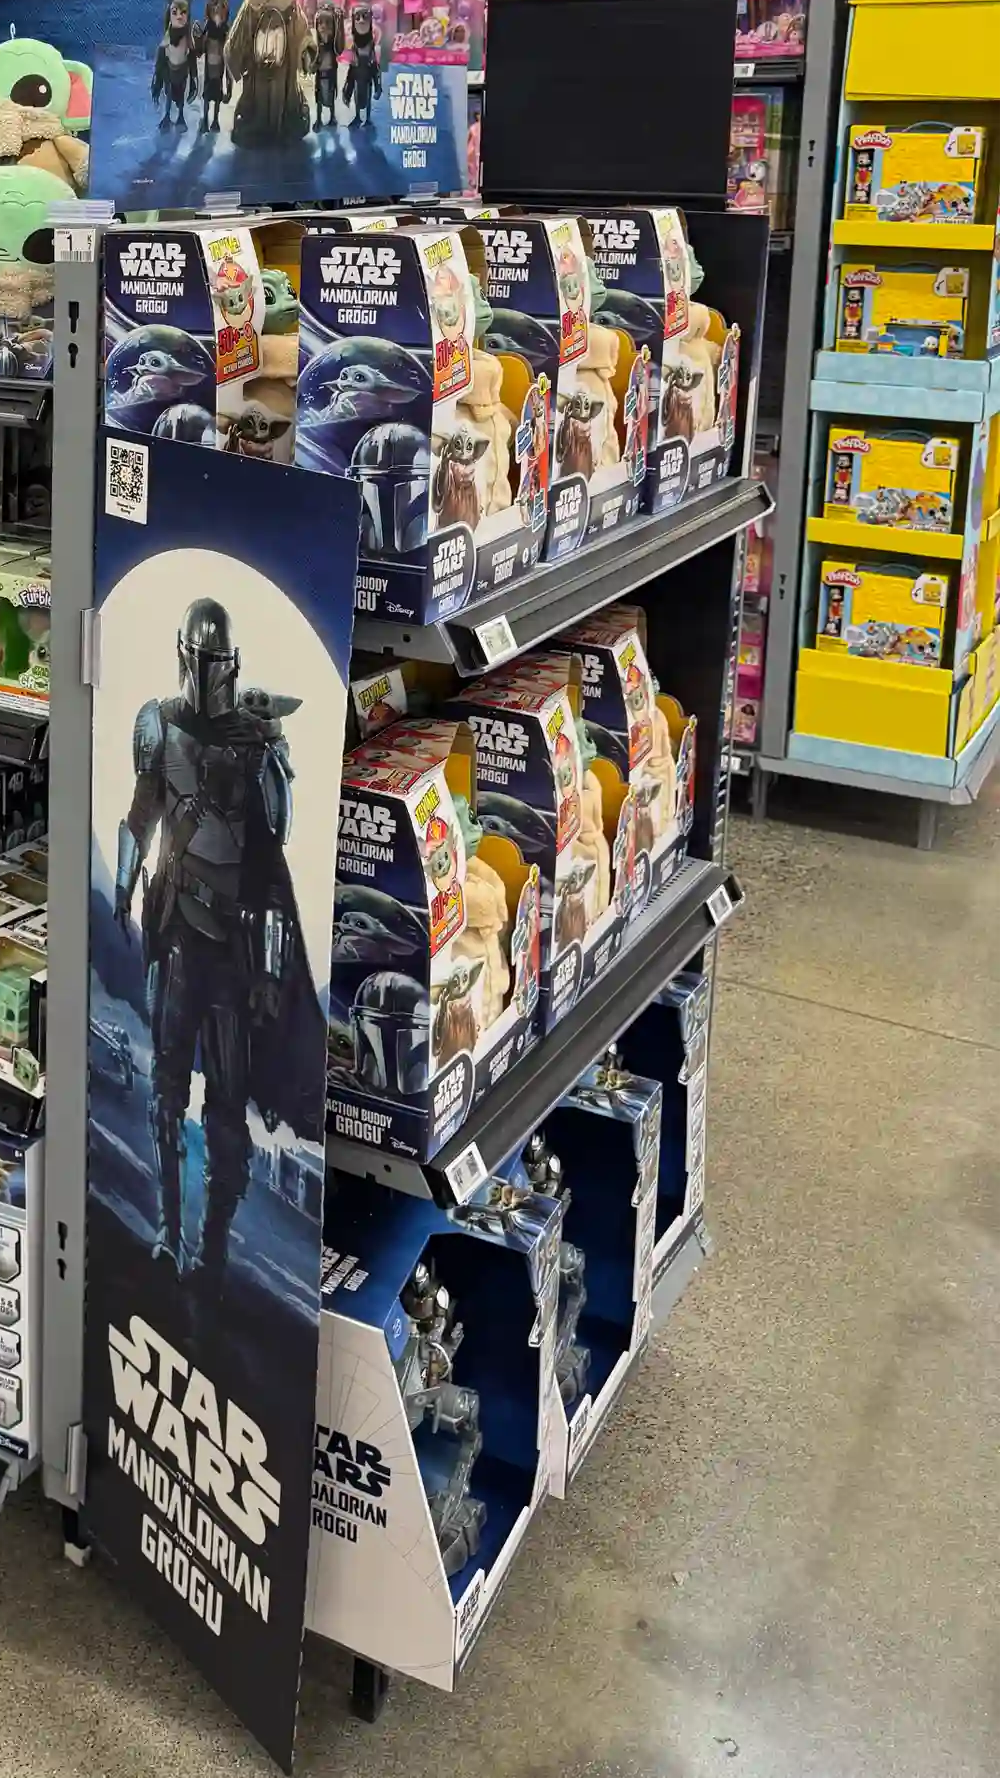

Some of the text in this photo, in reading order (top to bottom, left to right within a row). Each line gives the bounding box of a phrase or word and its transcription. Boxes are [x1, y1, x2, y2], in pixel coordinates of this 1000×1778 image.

[390, 73, 437, 96] STAR
[390, 96, 437, 119] WARS
[391, 126, 437, 144] MANDALORIAN
[403, 150, 426, 168] GROGU
[120, 242, 185, 260] STAR
[320, 246, 401, 267] STAR
[120, 260, 185, 278] WARS
[321, 266, 401, 286] WARS
[121, 281, 184, 296] MANDALORIAN
[320, 288, 397, 305] MANDALORIAN
[136, 300, 168, 314] GROGU
[338, 309, 376, 324] GROGU
[326, 1098, 392, 1128] ACTION BUDDY
[108, 1315, 281, 1505] STAR
[108, 1344, 280, 1545] WARS
[176, 1471, 195, 1492] THE
[108, 1416, 270, 1623] MANDALORIAN
[173, 1533, 193, 1556] AND
[141, 1513, 223, 1636] GROGU
